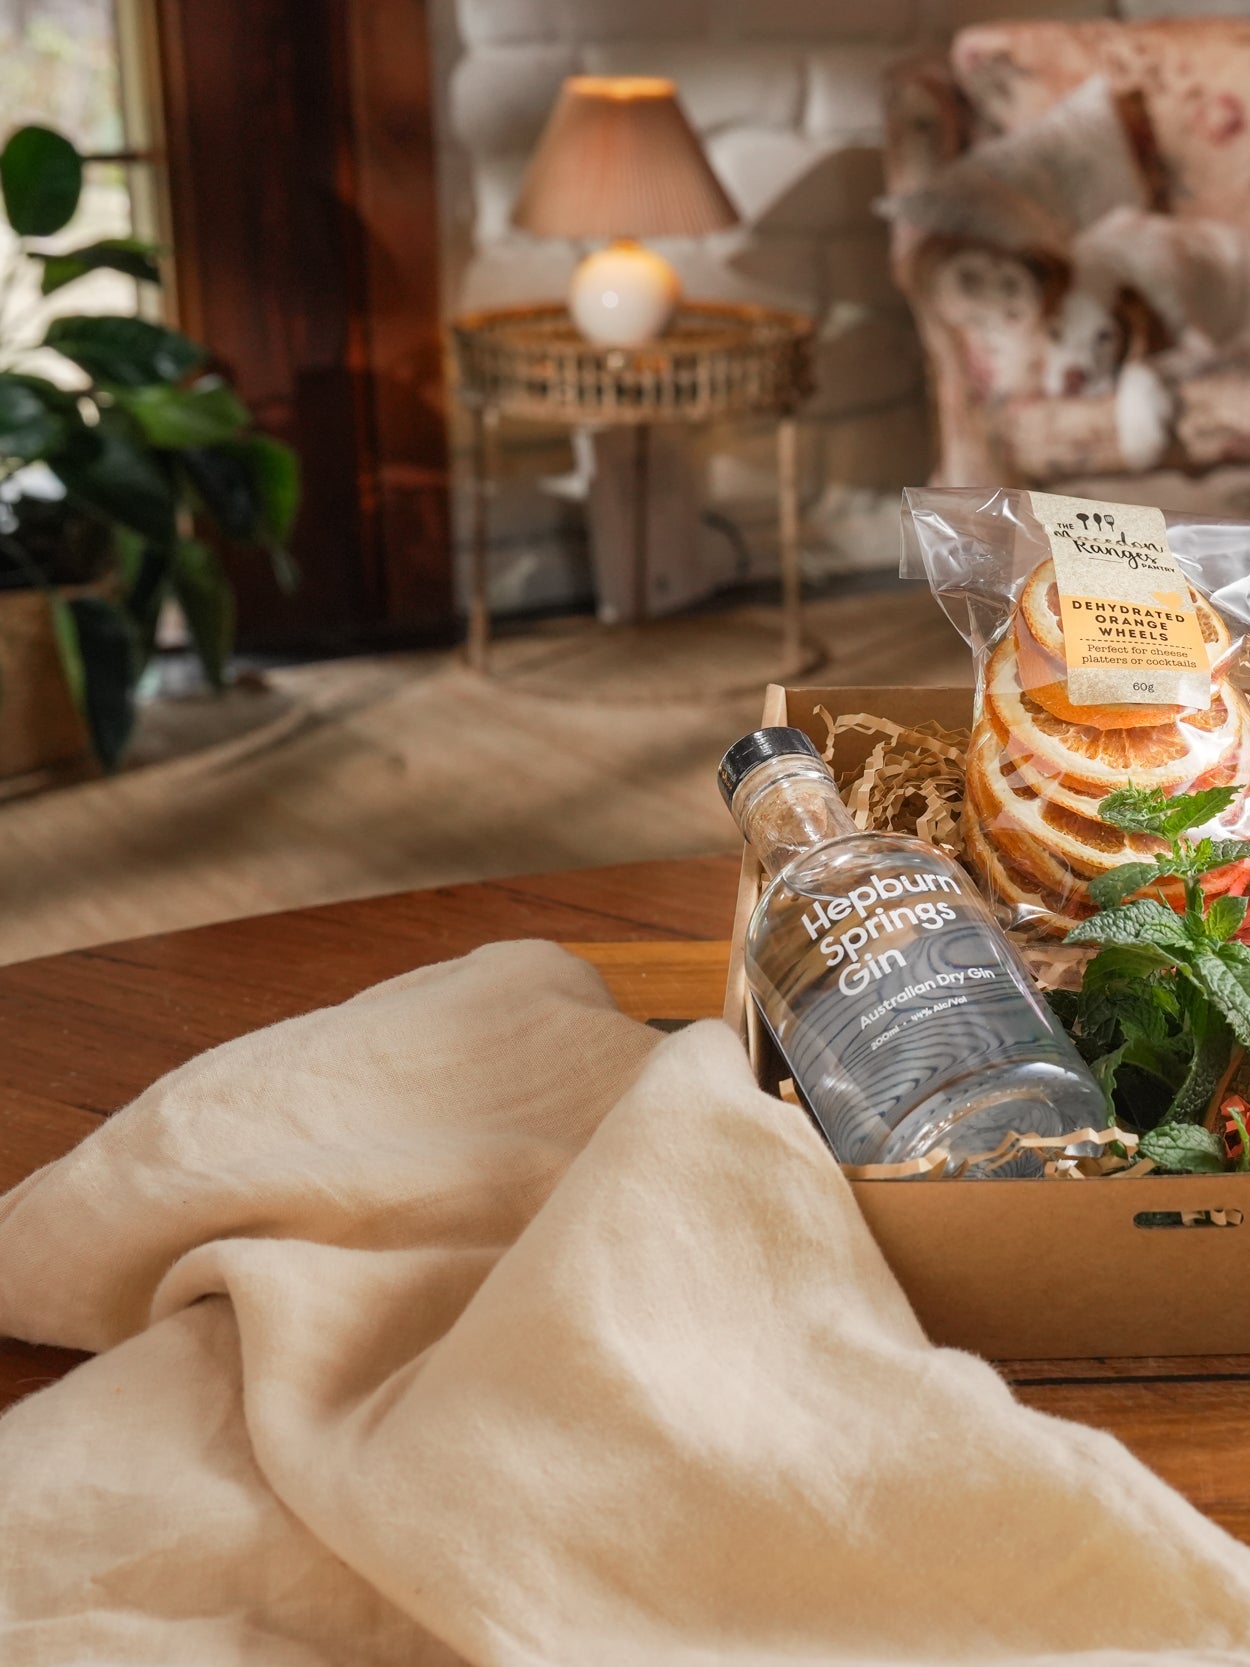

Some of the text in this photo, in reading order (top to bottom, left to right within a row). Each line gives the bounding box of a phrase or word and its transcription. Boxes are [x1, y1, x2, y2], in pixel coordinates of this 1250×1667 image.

[1073, 540, 1157, 570] Ranges
[1141, 563, 1175, 573] PANTRY
[1072, 600, 1185, 623] DEHYDRATED
[1095, 614, 1168, 631] ORANGE
[1098, 627, 1168, 641] WHEELS
[1082, 655, 1128, 664] platters
[1146, 658, 1197, 668] cocktails
[1087, 644, 1188, 658] Perfect for cheese
[1132, 682, 1155, 693] 60g
[801, 872, 963, 941] Hepburn
[819, 901, 958, 967] Springs
[839, 949, 907, 996] Gin
[859, 967, 996, 1030] Australian Dry Gin
[870, 995, 968, 1051] 200ml 44% Alc/Vol
